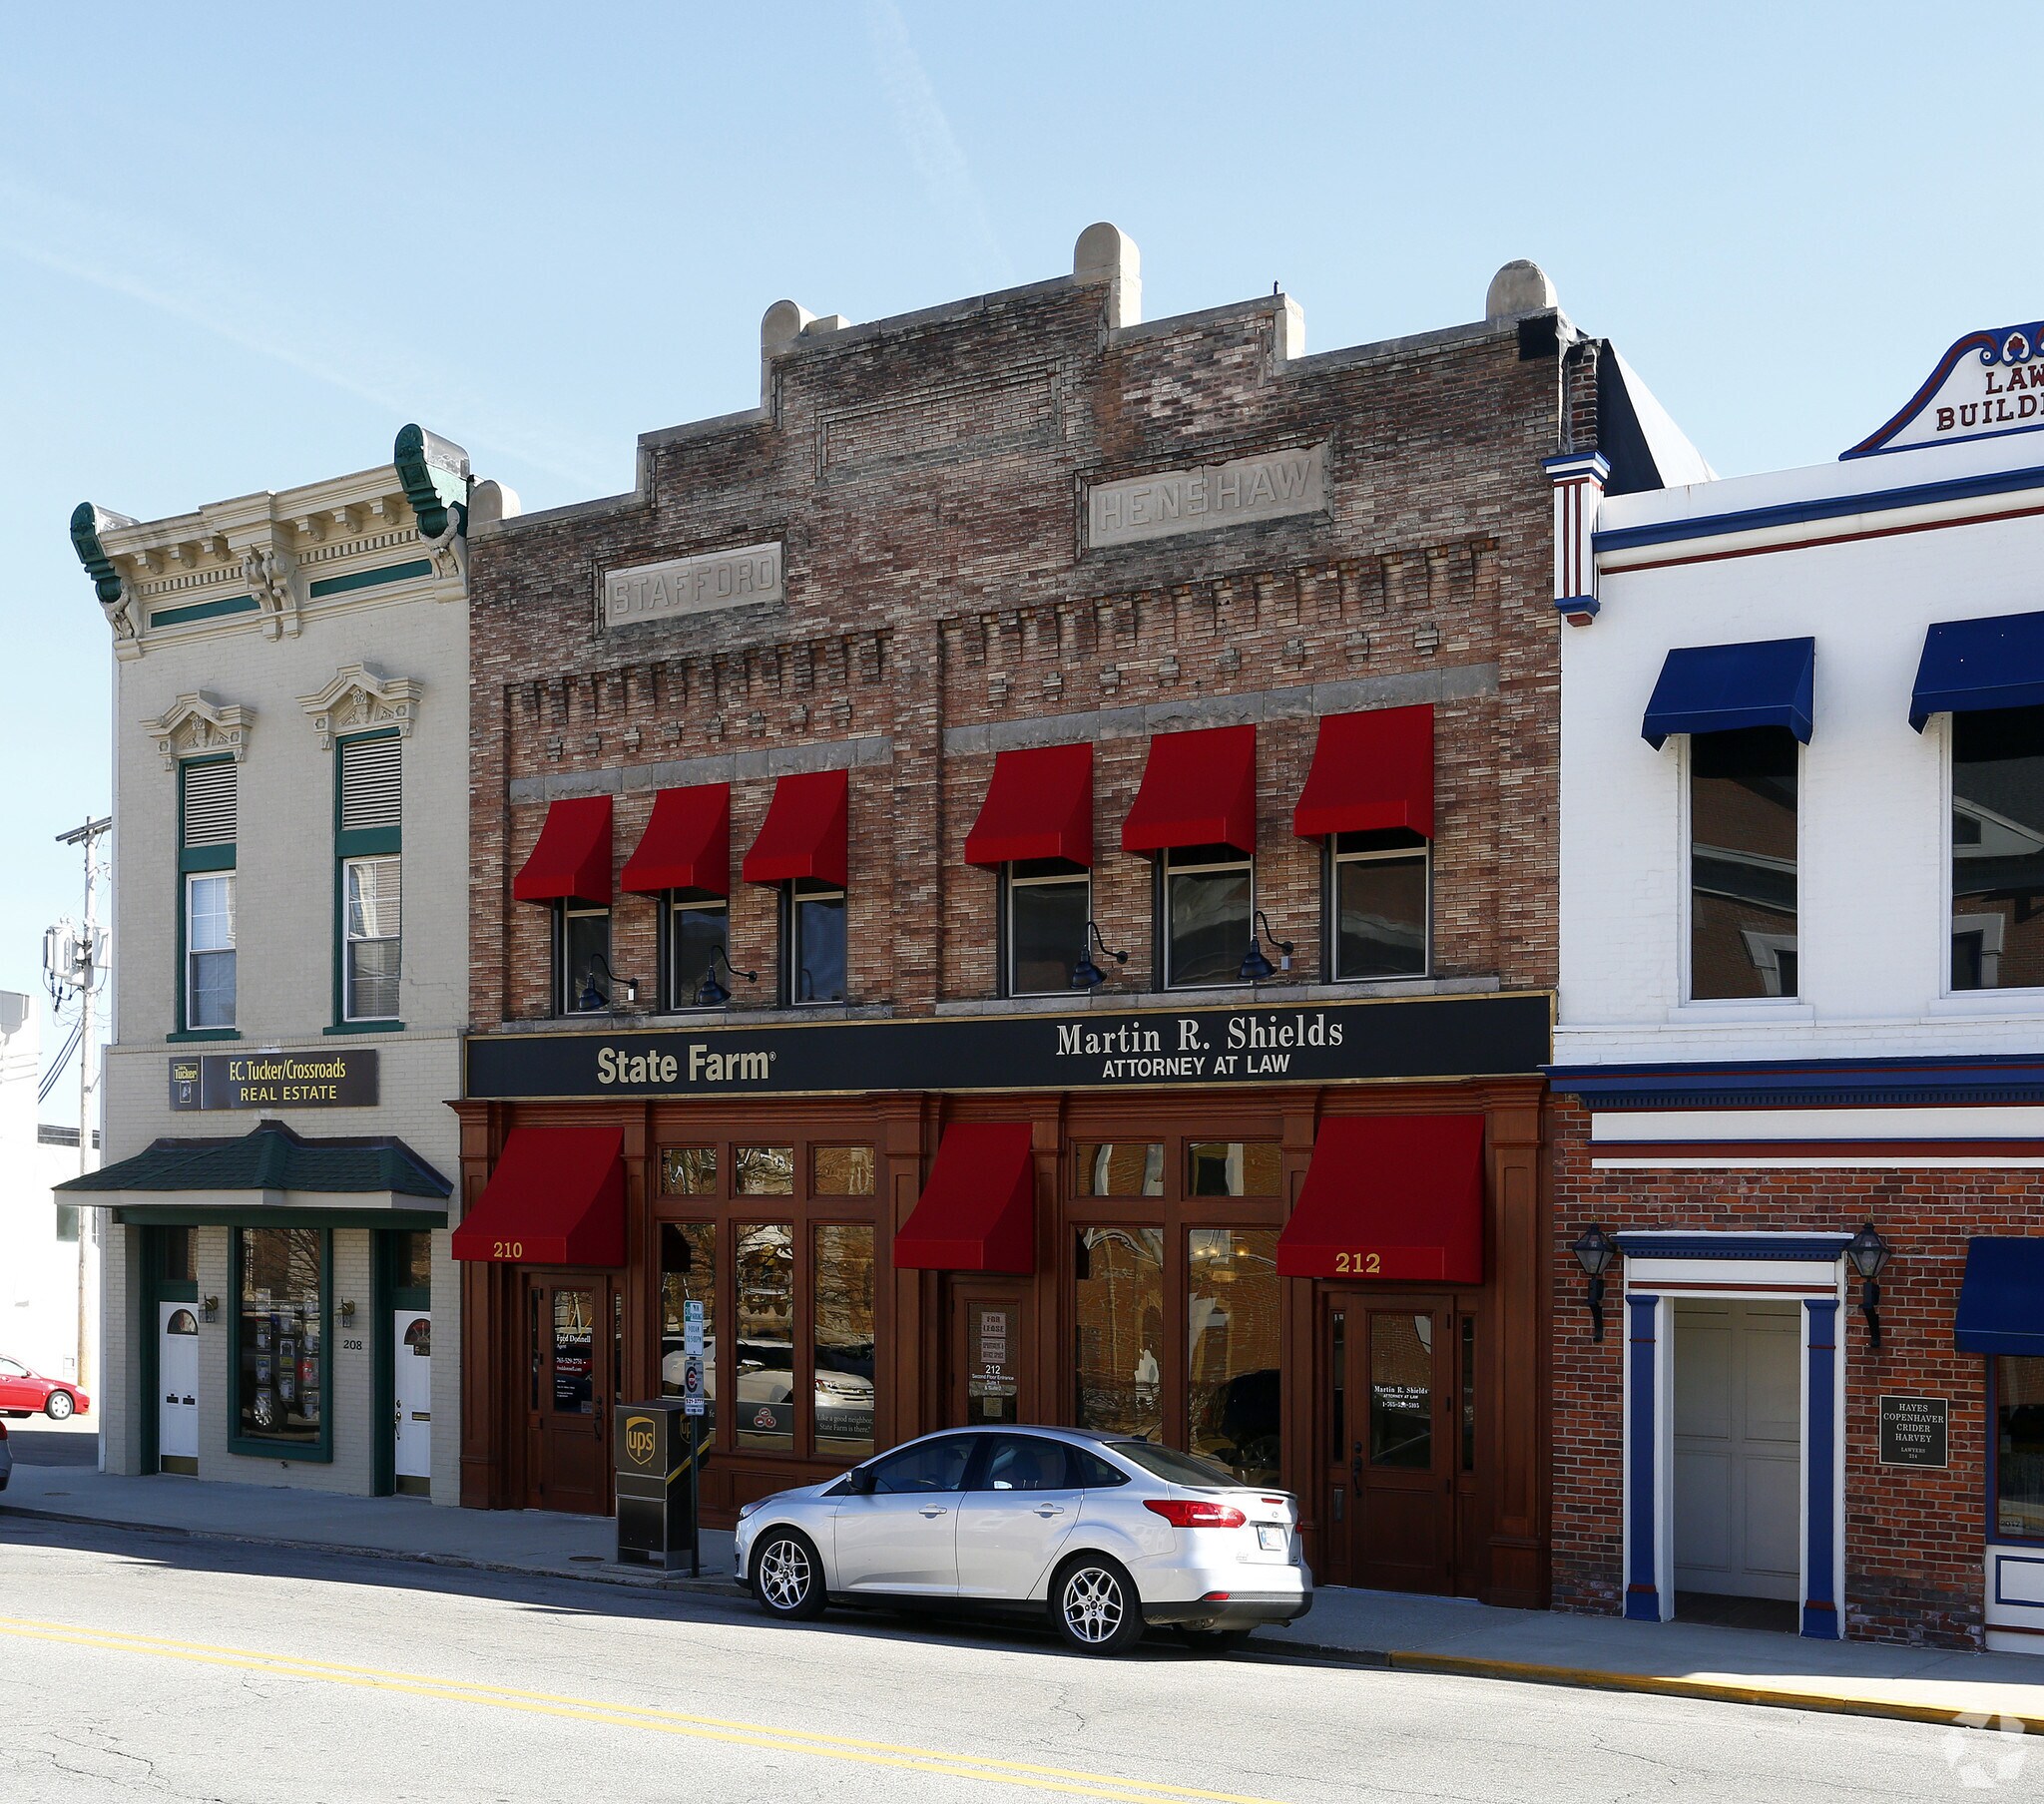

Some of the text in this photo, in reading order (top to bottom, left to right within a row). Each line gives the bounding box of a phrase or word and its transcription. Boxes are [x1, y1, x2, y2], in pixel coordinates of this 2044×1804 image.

[1100, 459, 1310, 531] HENSHAW
[614, 555, 774, 615] STAFFORD
[1056, 1014, 1343, 1056] Martin R. Shields
[175, 1069, 198, 1080] Tucker
[229, 1057, 346, 1082] F.C. Tucker/Crossroads
[597, 1047, 678, 1085] State
[1102, 1054, 1290, 1079] ATTORNEY AT LAW
[241, 1085, 337, 1102] REAL ESTATE
[493, 1241, 523, 1258] 210
[1335, 1252, 1380, 1274] 212
[983, 1324, 1005, 1333] LEASE
[342, 1339, 362, 1351] 208
[985, 1365, 1001, 1375] 212
[1898, 1403, 1928, 1413] HAYES
[816, 1413, 829, 1422] Like
[833, 1415, 847, 1424] good
[1883, 1413, 1944, 1423] COPENHAVER
[1896, 1423, 1930, 1433] CRIDER
[628, 1430, 654, 1457] ups
[1895, 1433, 1932, 1443] HARVEY
